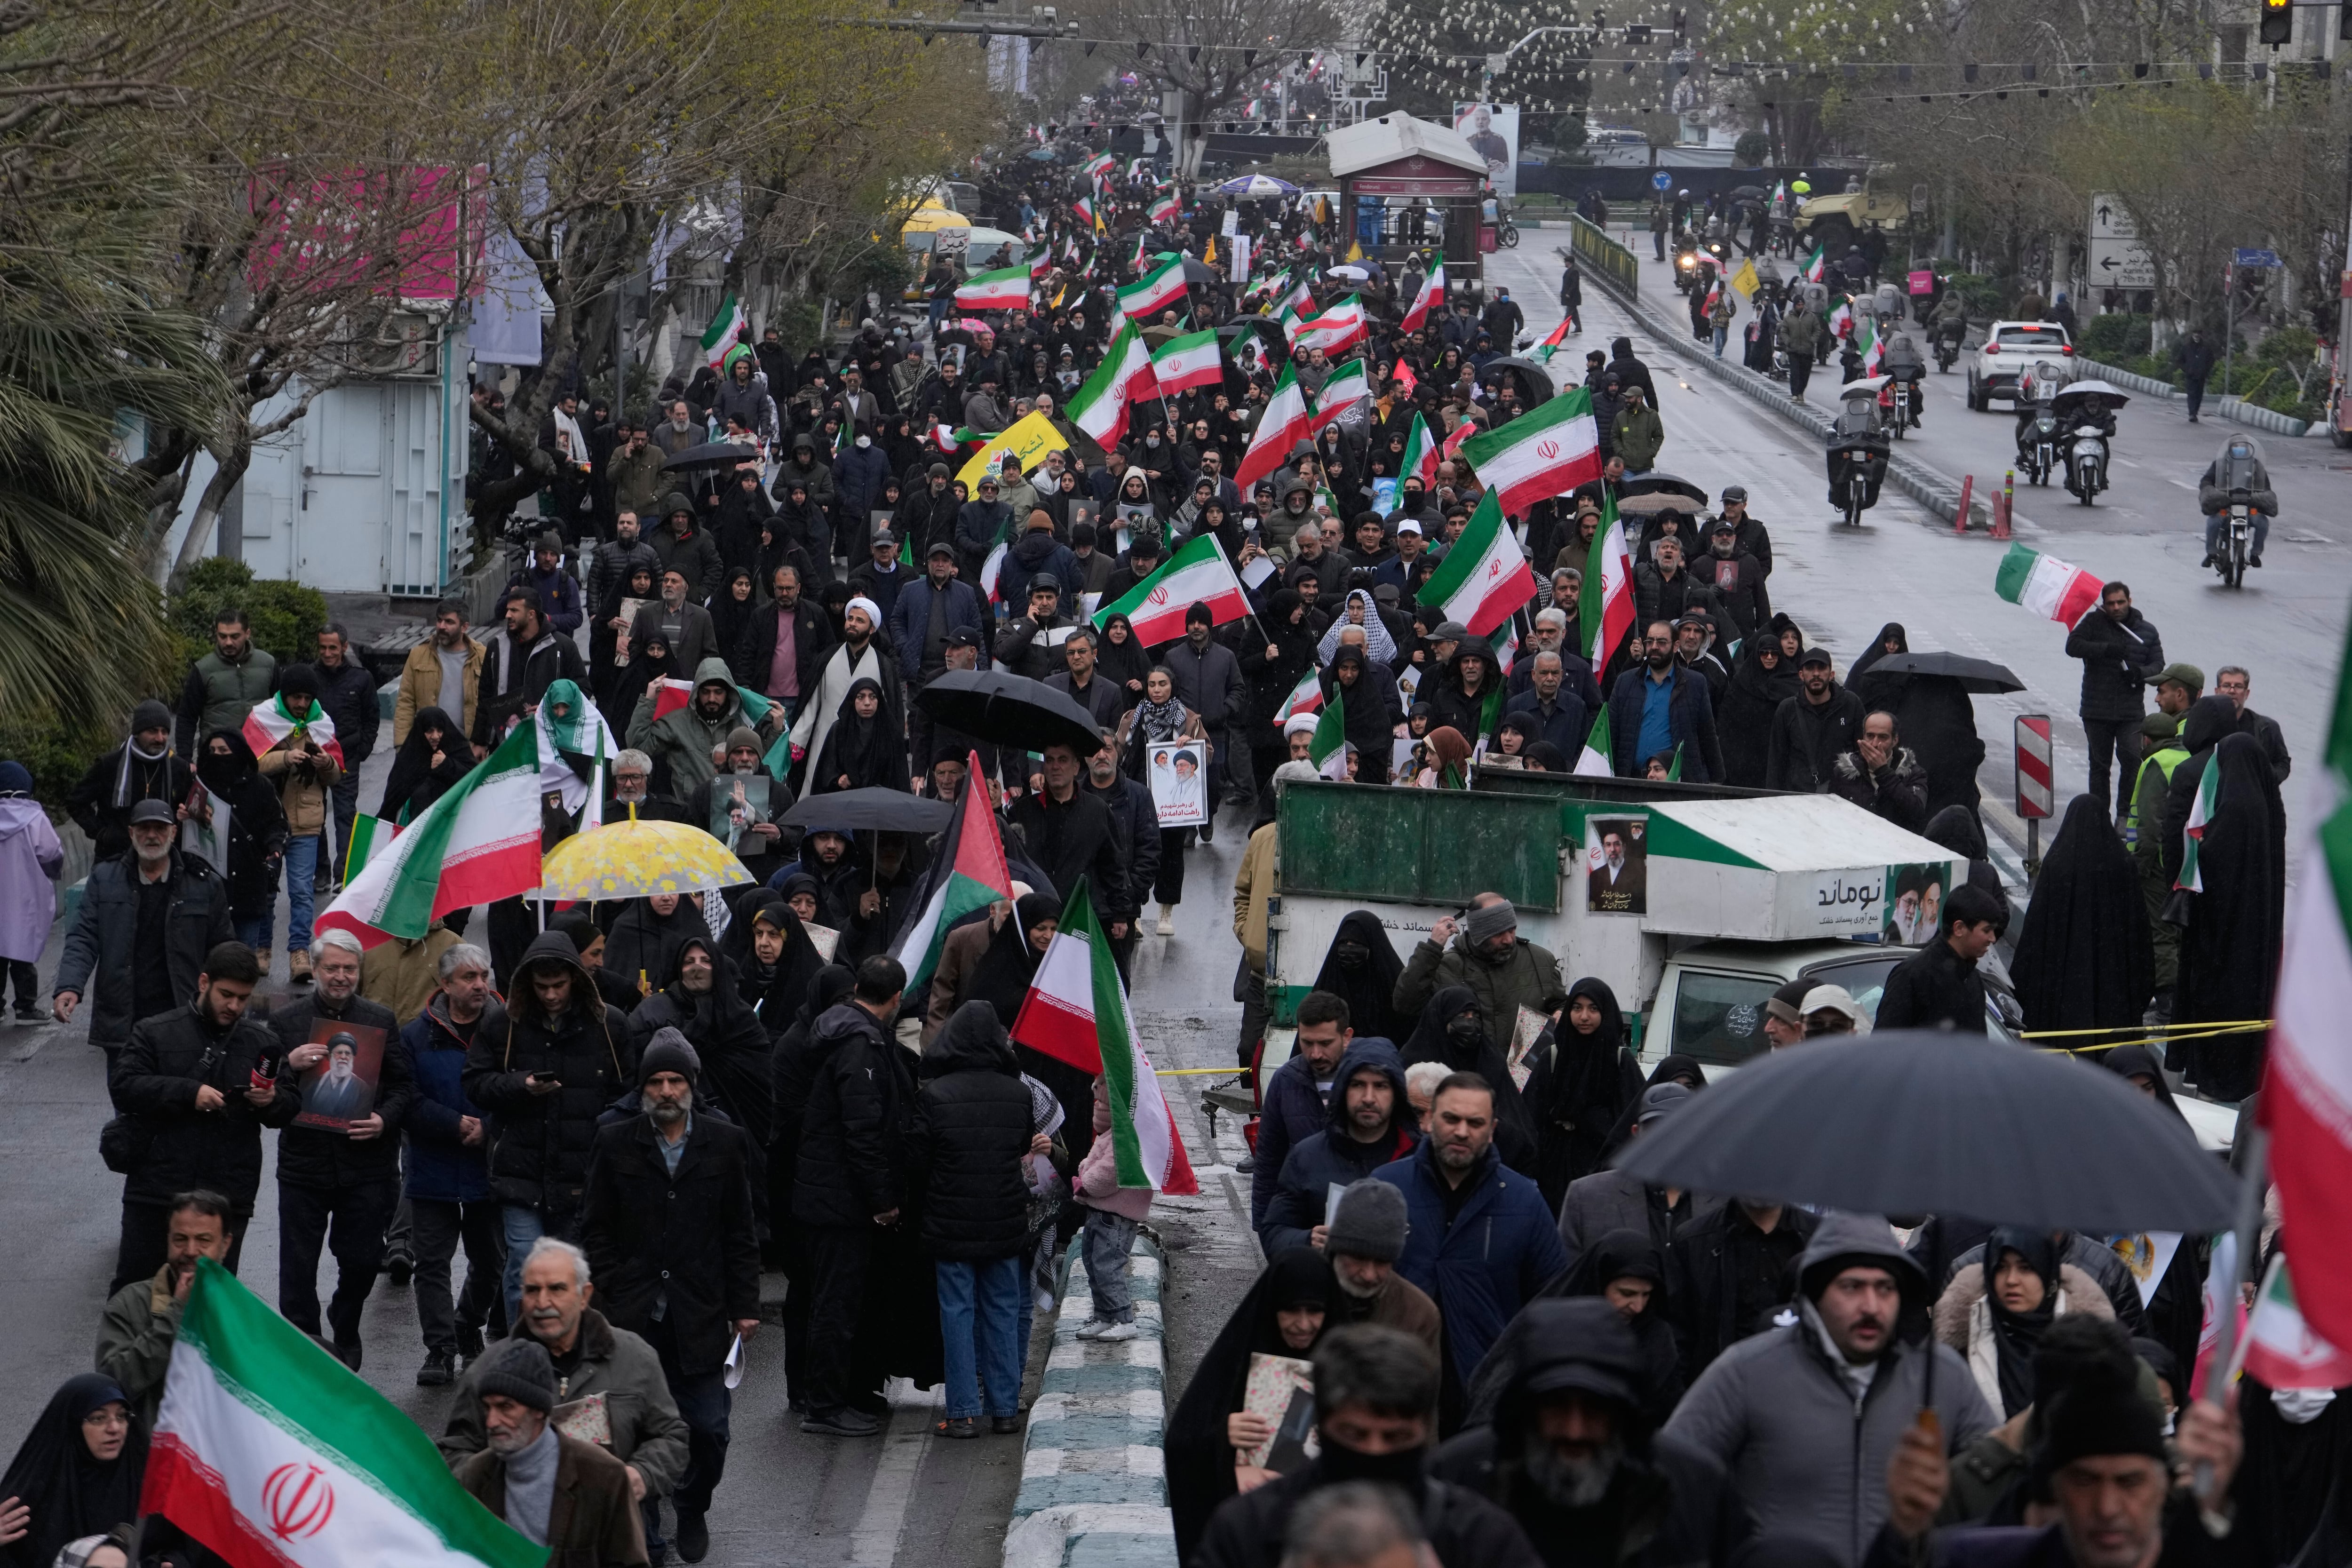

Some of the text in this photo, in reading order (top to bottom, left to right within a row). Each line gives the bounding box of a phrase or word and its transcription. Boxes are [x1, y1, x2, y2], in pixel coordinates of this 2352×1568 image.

[943, 229, 967, 238] سلام
[938, 240, 968, 253] رهبر
[1819, 878, 1881, 911] نوماند
[1835, 916, 1852, 925] پسماند
[1854, 913, 1867, 923] آوری
[1868, 915, 1878, 924] جمع
[1403, 922, 1433, 932] سماند
